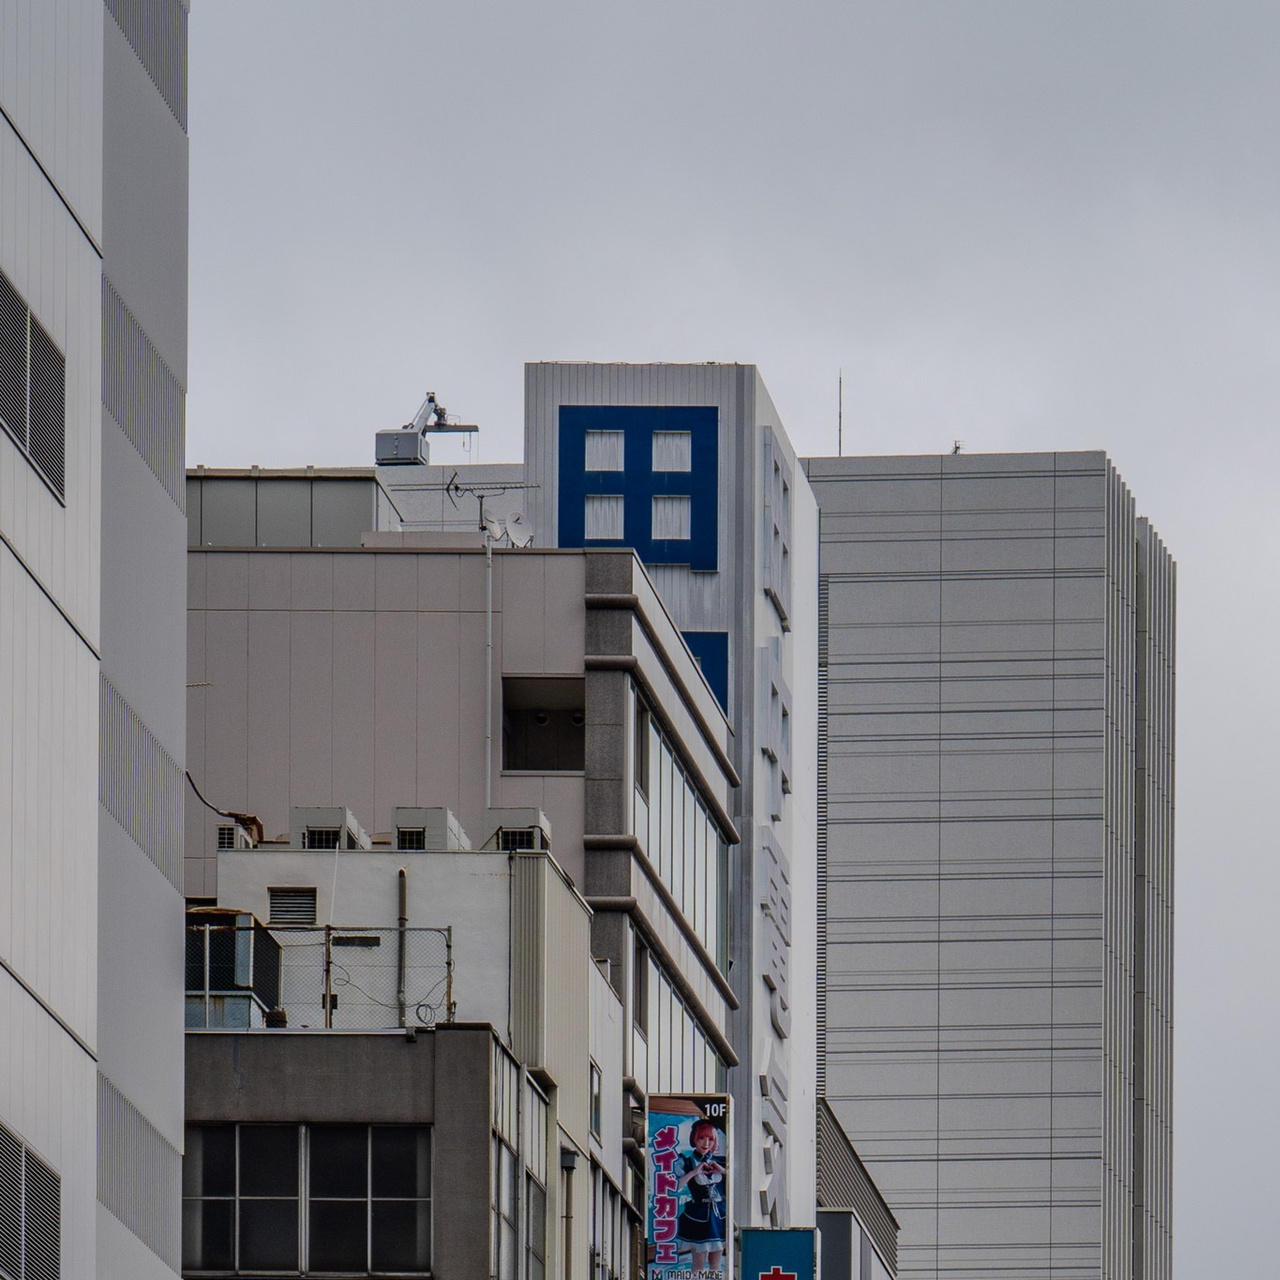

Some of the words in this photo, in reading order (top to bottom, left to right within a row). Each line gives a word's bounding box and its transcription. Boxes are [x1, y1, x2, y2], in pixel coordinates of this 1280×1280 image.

[705, 1104, 726, 1117] 10F
[653, 1125, 678, 1264] メイドカフェ
